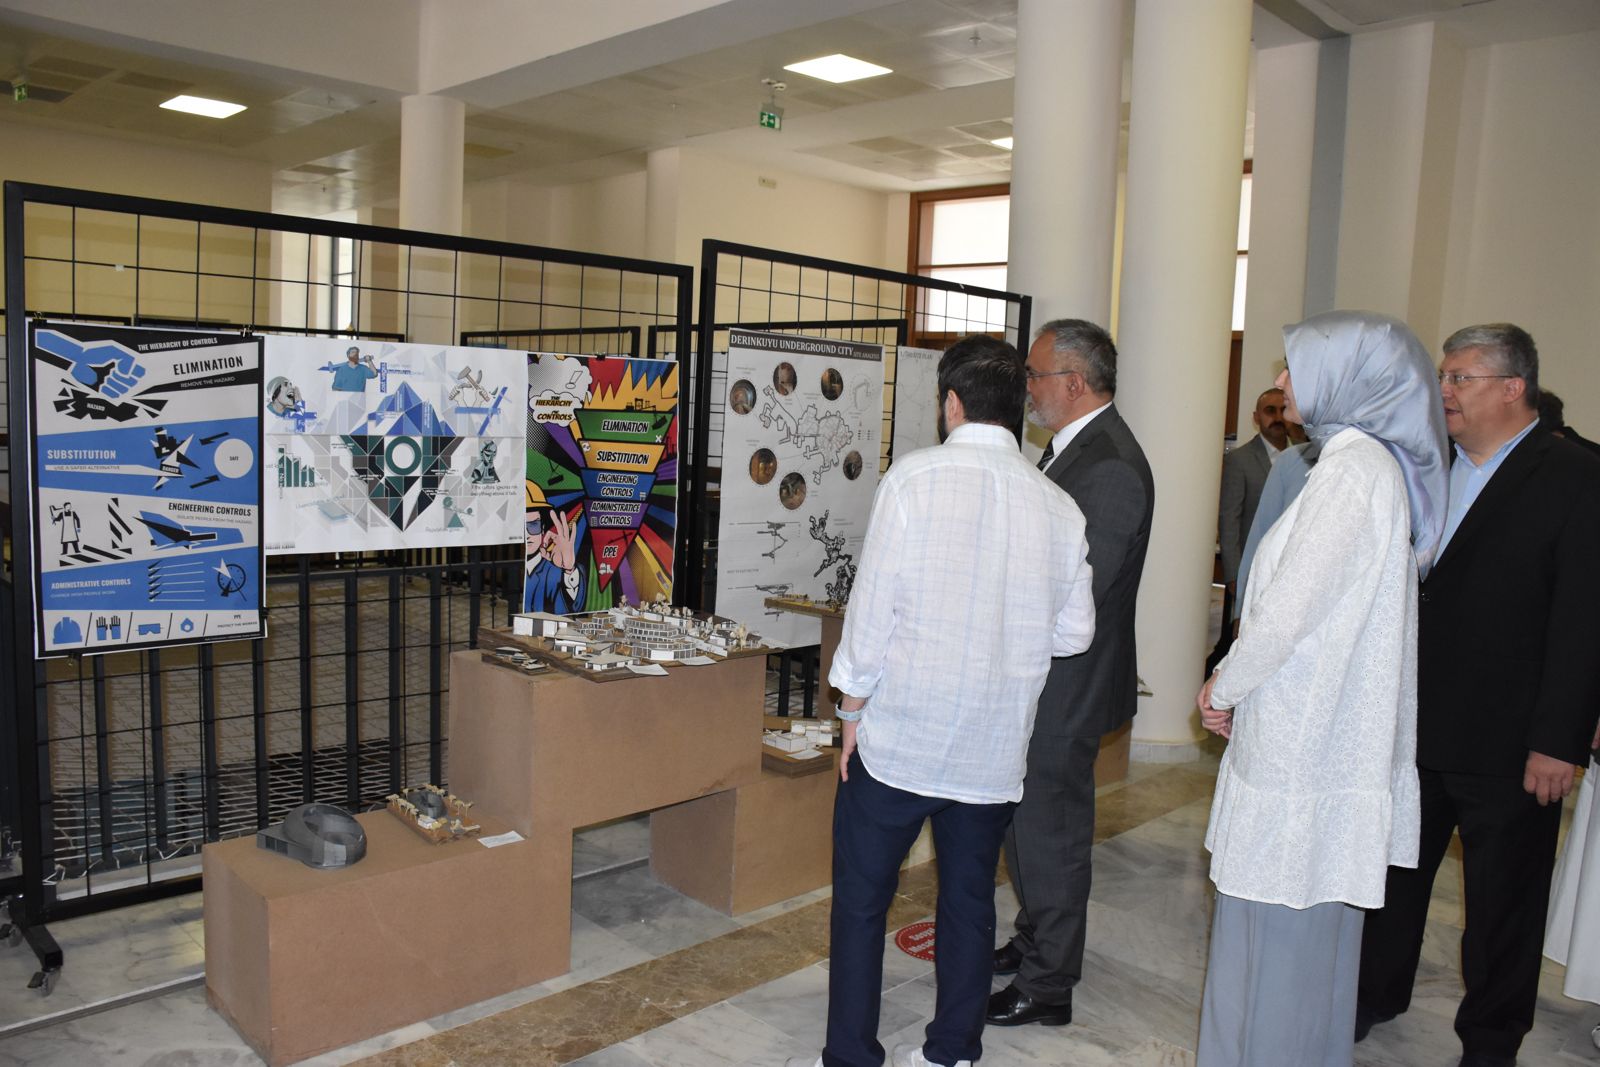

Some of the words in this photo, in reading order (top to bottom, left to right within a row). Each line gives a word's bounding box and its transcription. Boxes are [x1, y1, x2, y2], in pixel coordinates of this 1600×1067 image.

[149, 341, 181, 350] HIERARCHY
[190, 337, 218, 346] CONTROLS
[731, 334, 778, 348] DERINKUYU
[779, 339, 837, 353] UNDERGROUND
[838, 346, 854, 356] CITY
[173, 356, 243, 376] ELIMINATION
[213, 376, 236, 384] HAZARD
[86, 402, 105, 412] HAZARD
[535, 399, 573, 407] HIERARCHY
[602, 420, 649, 433] ELIMINATION
[47, 449, 116, 460] SUBSTITUTION
[597, 451, 649, 464] SUBSTITUTION
[597, 473, 638, 484] ENGINEERING
[601, 487, 633, 497] CONTROLS
[168, 502, 214, 514] ENGINEERING
[216, 506, 252, 517] CONTROLS
[600, 516, 631, 525] CONTROLS
[603, 546, 618, 557] PPE
[51, 580, 100, 590] ADMINISTRATIVE
[101, 578, 131, 587] CONTROLS
